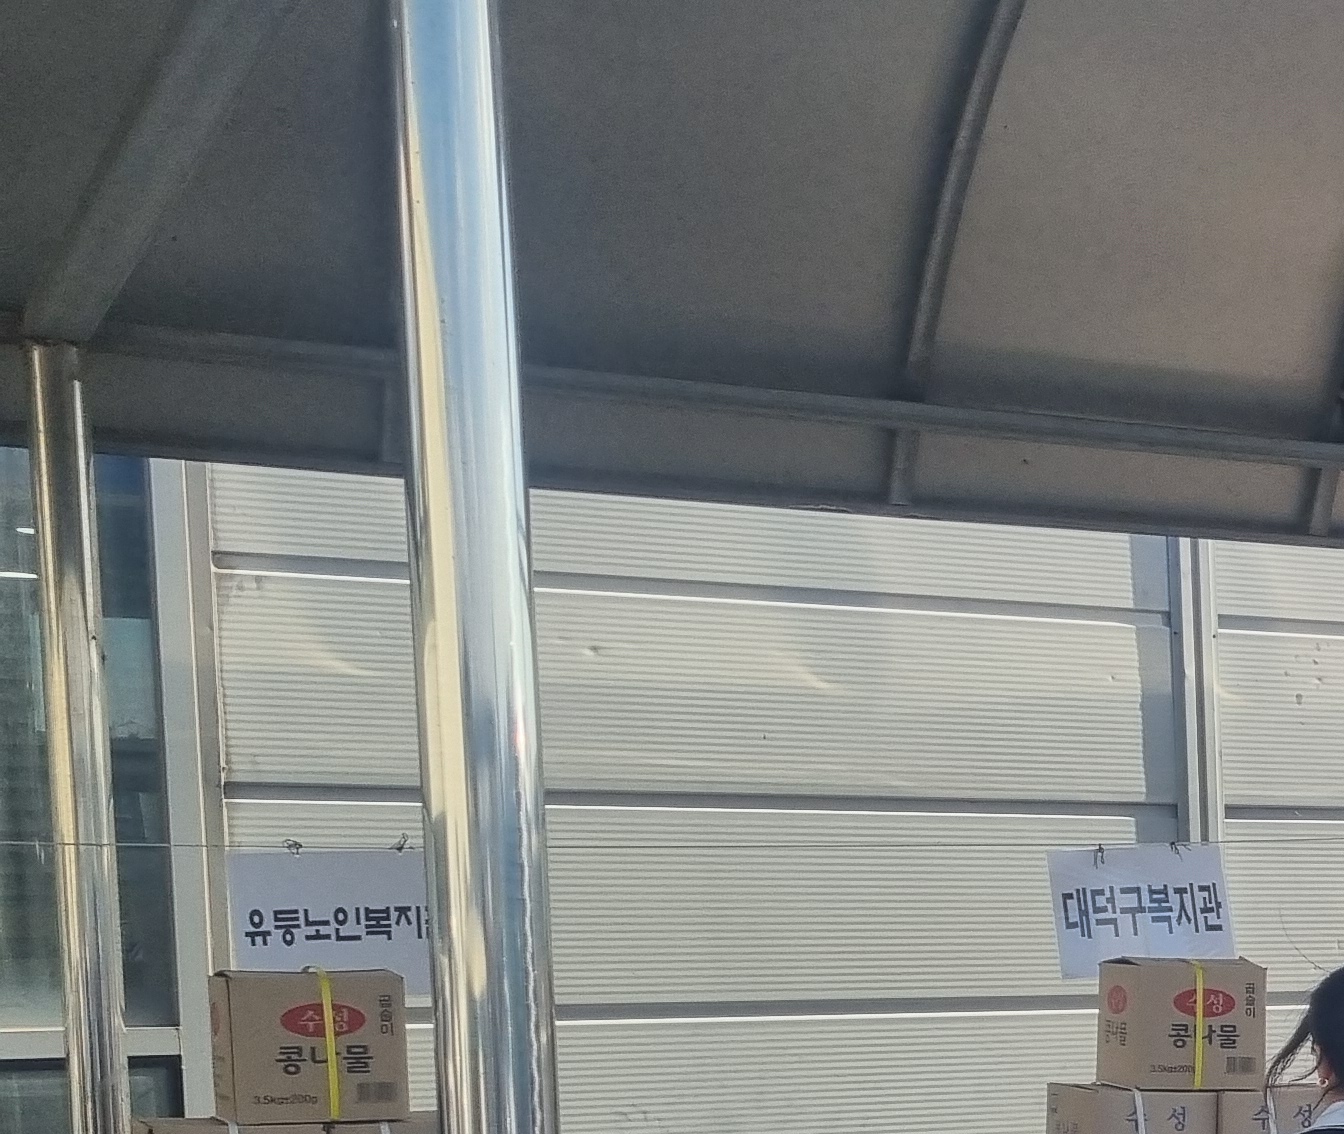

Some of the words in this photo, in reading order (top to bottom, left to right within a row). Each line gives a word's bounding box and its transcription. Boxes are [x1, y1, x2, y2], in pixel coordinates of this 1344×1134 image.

[244, 905, 429, 947] 유등노인복지
[1061, 882, 1224, 939] 대덕구복지관
[1168, 1023, 1241, 1050] 콩나물
[275, 1045, 374, 1075] 콩나물
